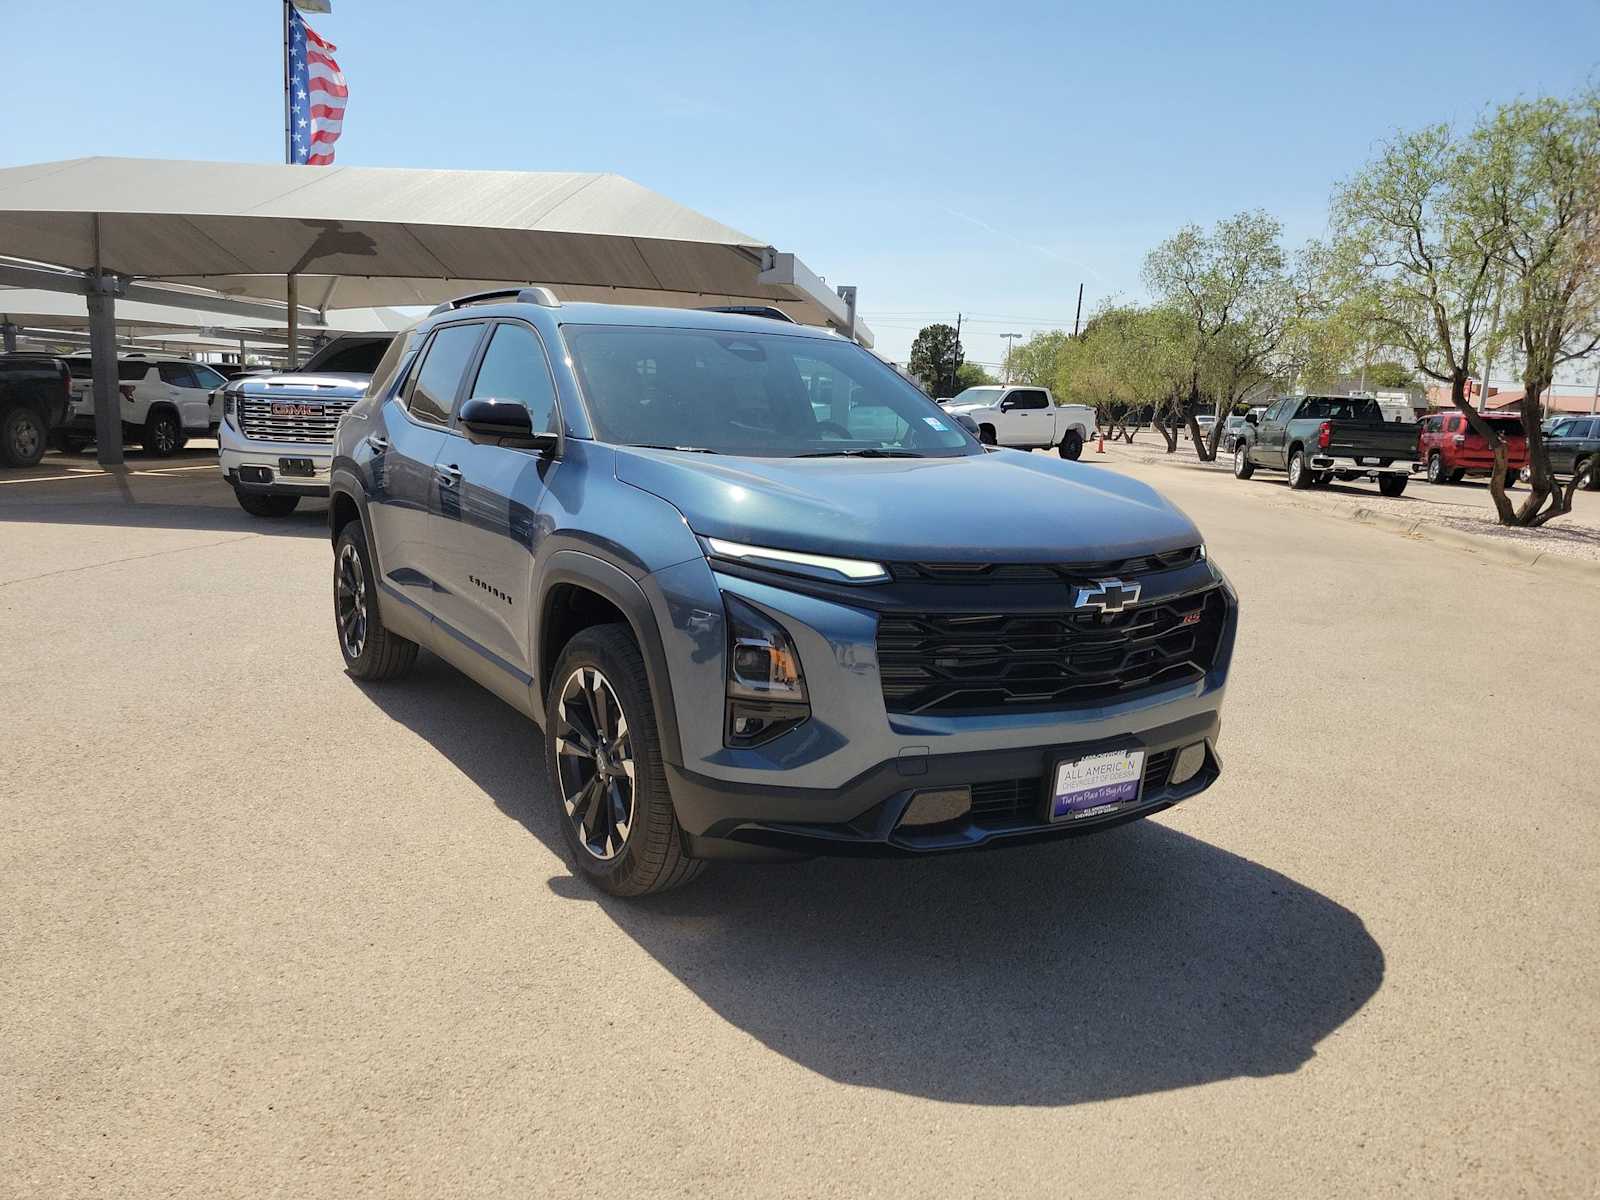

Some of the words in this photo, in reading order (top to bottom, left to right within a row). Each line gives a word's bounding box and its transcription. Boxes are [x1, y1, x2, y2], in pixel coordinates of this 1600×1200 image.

[272, 403, 323, 416] GMC
[1064, 769, 1082, 781] ALL
[1062, 796, 1072, 805] The
